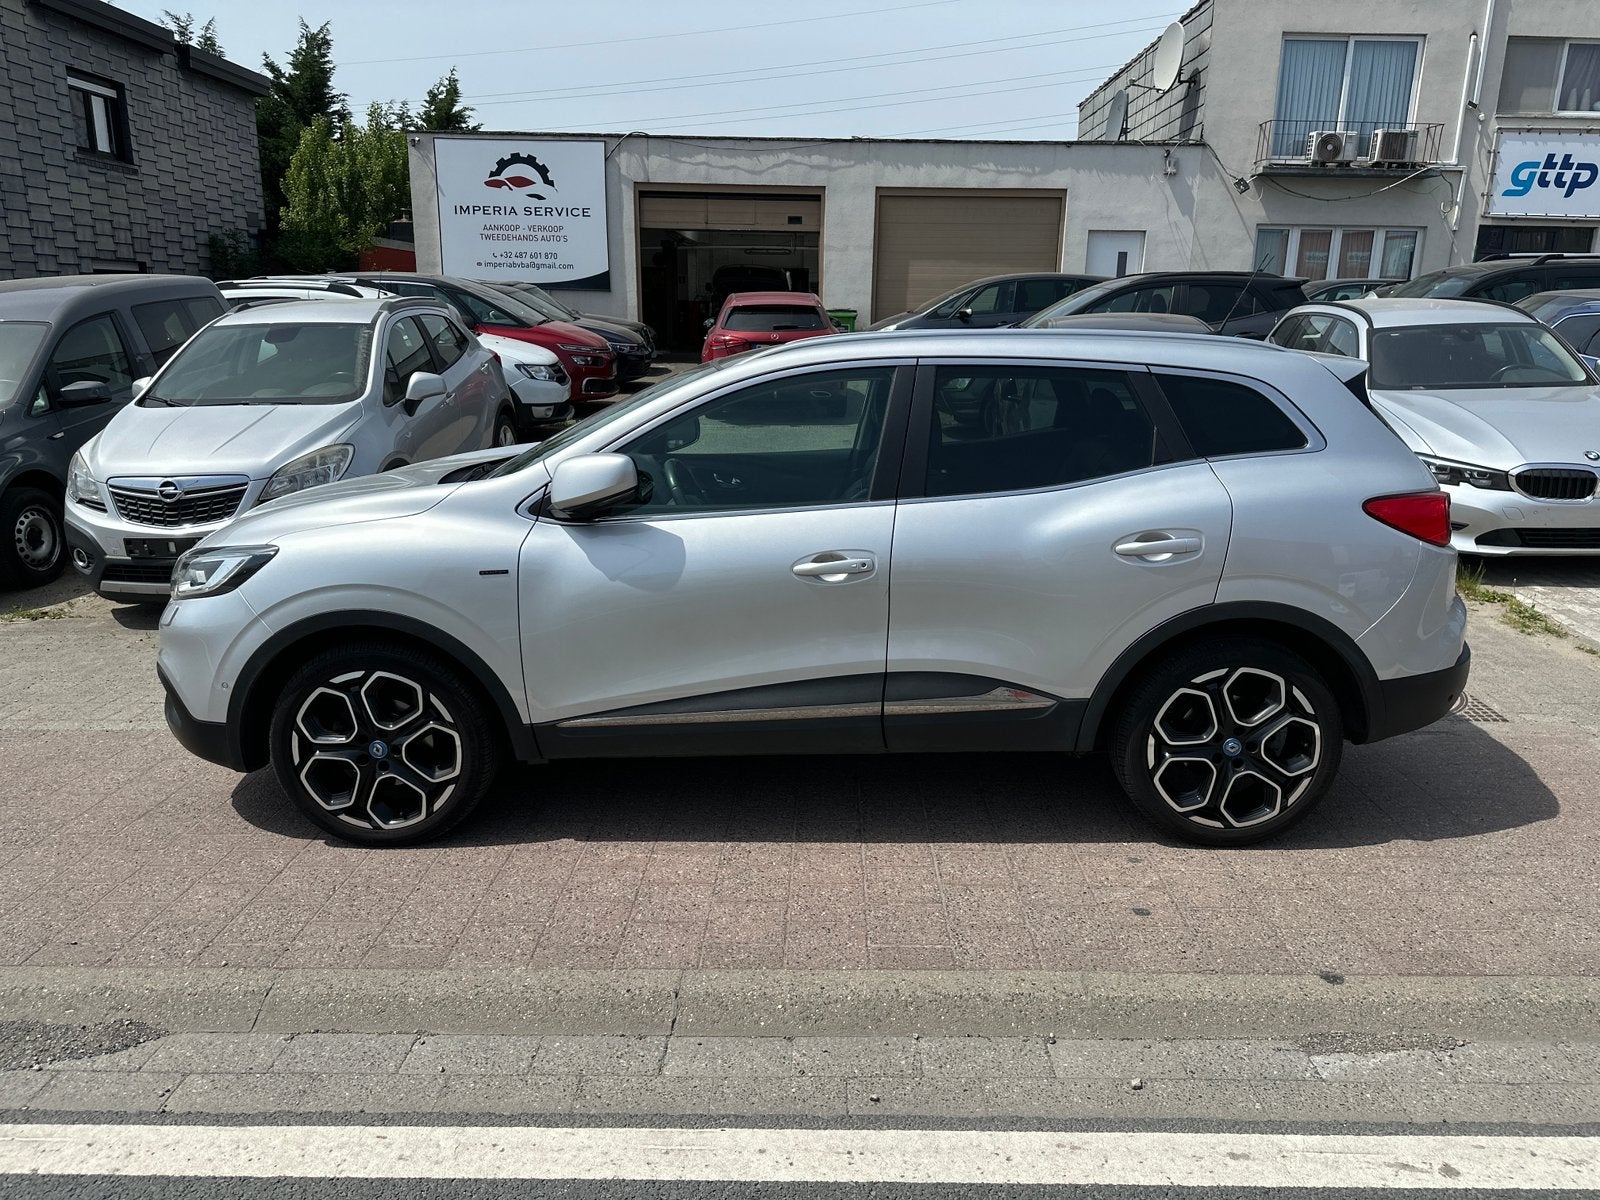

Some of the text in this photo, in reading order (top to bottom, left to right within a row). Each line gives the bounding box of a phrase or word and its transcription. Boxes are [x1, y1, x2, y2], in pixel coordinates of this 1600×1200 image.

[1501, 153, 1599, 198] gttp
[454, 205, 591, 218] IMPERIA SERVICE
[482, 224, 521, 232] AANKOOP
[527, 225, 564, 233] VERKOOP
[480, 233, 569, 243] TWEEDEHANDS AUTO'S
[499, 251, 513, 259] +32
[529, 252, 542, 260] 601
[544, 252, 558, 260] 870
[484, 260, 575, 271] imperiabvba@gmail.com
